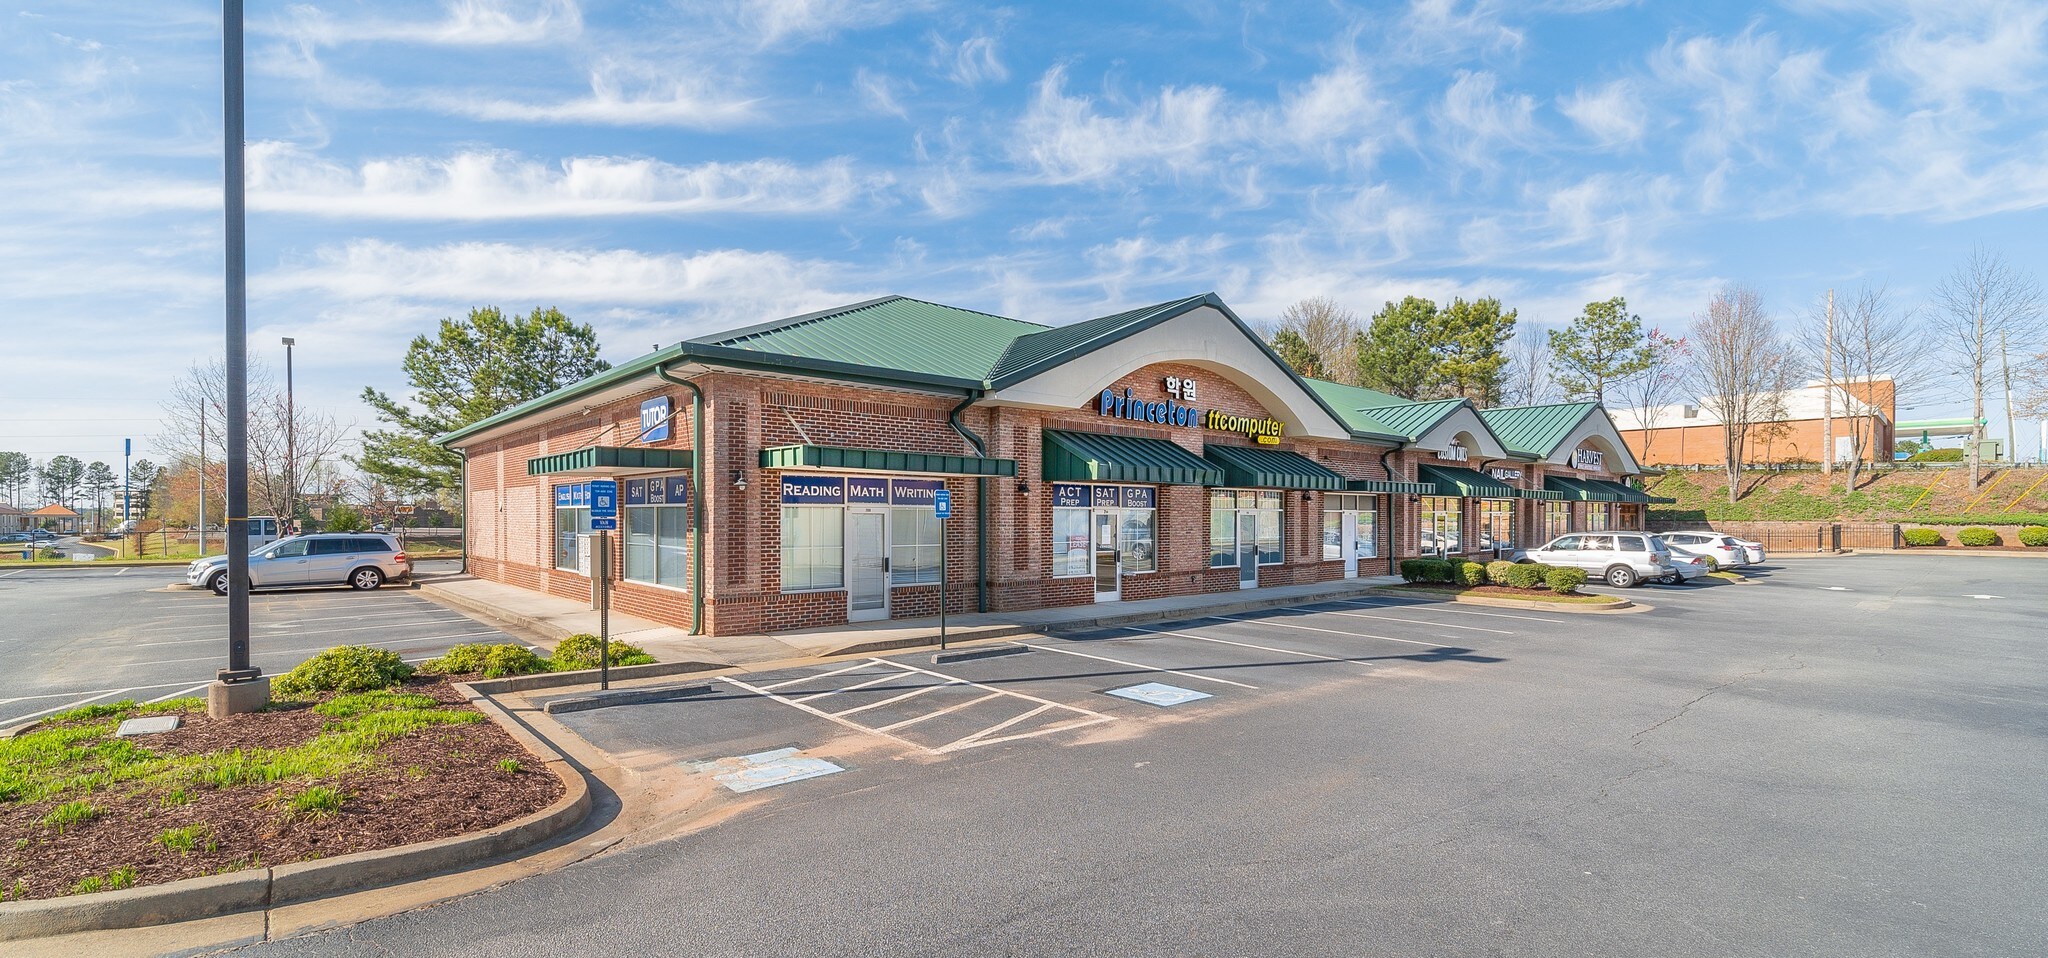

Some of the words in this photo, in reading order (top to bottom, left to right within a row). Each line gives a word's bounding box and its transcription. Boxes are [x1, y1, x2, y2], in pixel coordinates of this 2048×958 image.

[1166, 376, 1197, 401] 학원
[1101, 388, 1198, 428] Princeton
[642, 405, 667, 428] TUTOR
[1208, 410, 1285, 437] ttcomputer
[1578, 449, 1603, 465] HARVEST
[631, 486, 643, 498] SAT
[674, 484, 684, 497] AP
[783, 483, 841, 497] READING
[850, 485, 884, 497] MATH
[894, 486, 936, 498] WRITIN
[1059, 487, 1081, 497] ACT
[1096, 488, 1114, 498] SAT
[1127, 489, 1148, 499] GPA
[1060, 498, 1079, 506] PREP
[1096, 499, 1114, 507] PREP
[1128, 499, 1147, 507] BOOST
